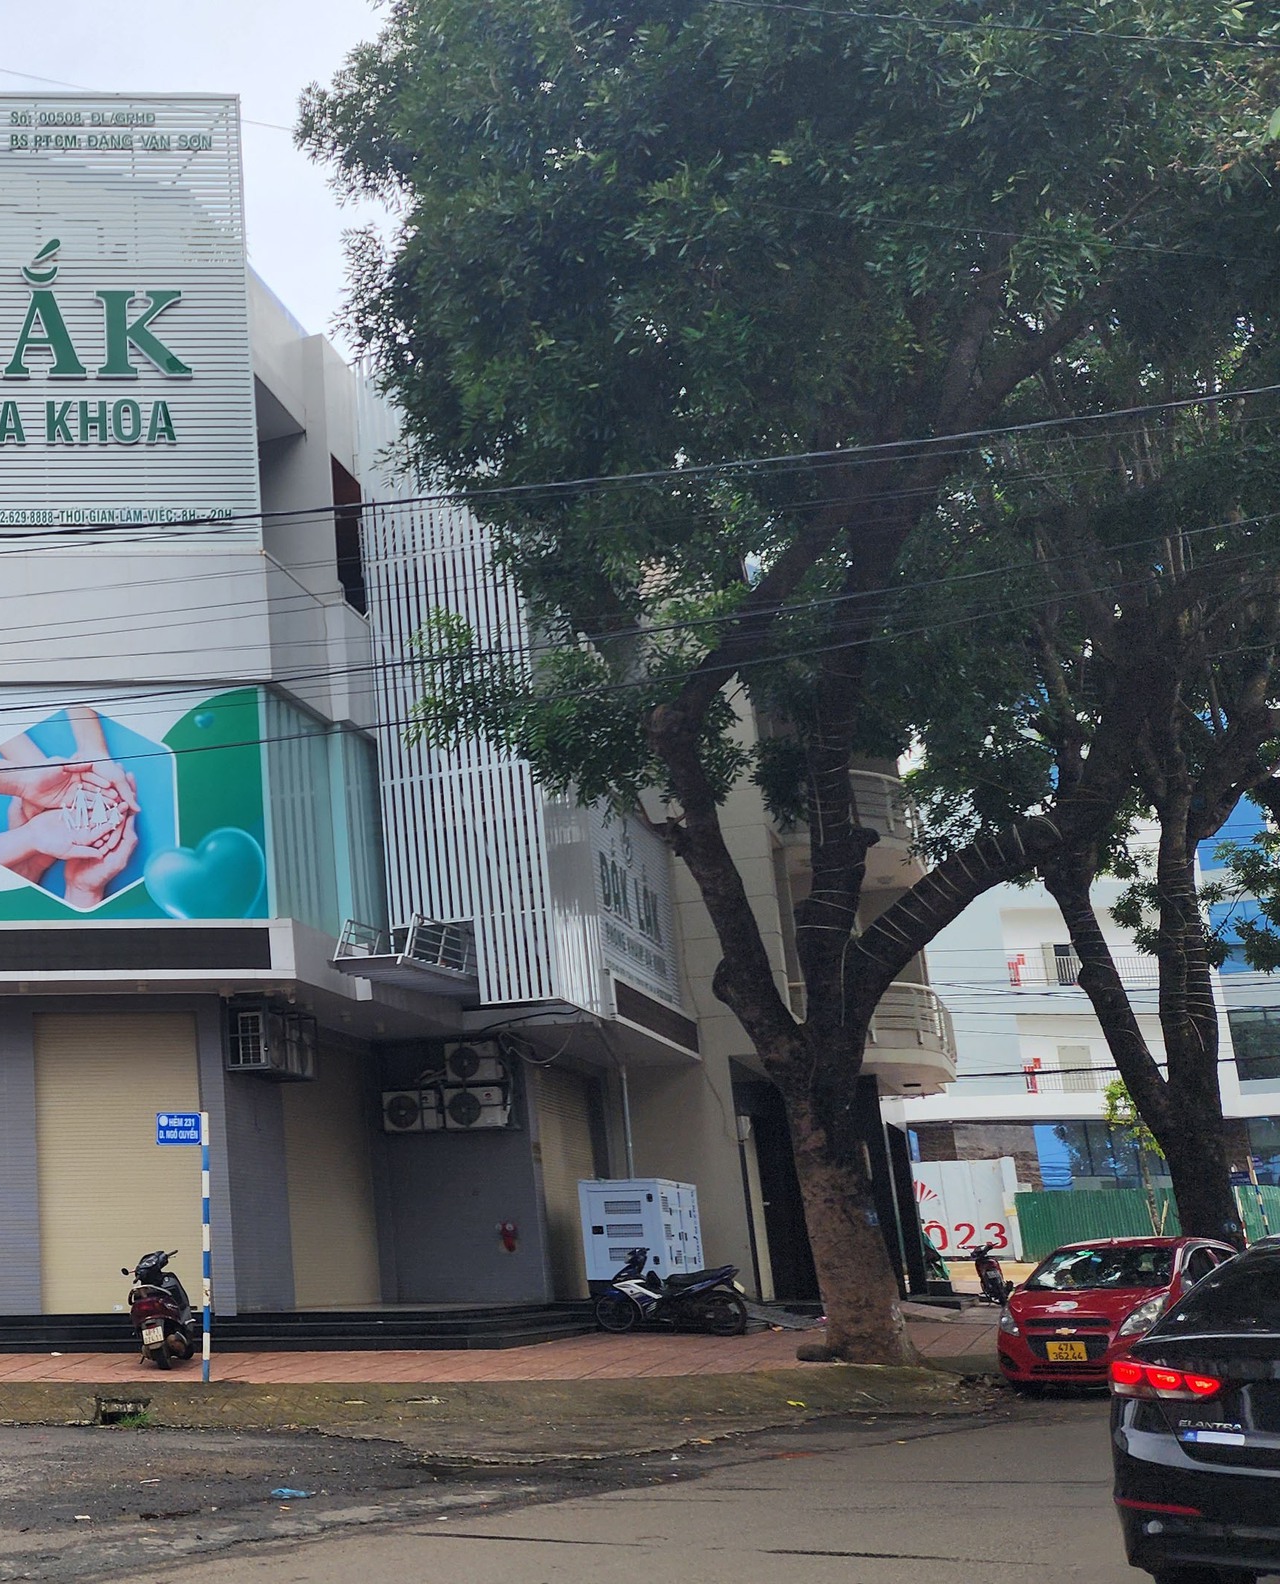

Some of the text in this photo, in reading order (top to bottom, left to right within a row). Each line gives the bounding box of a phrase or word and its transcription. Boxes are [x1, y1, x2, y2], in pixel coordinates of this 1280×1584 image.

[10, 134, 29, 146] BS
[140, 131, 171, 148] VĂN
[178, 133, 213, 148] SƠN
[45, 399, 177, 446] KHOA
[89, 509, 116, 522] GIAN
[181, 509, 196, 521] 8H
[184, 1117, 195, 1127] 231
[1178, 1419, 1242, 1432] ELANTRA
